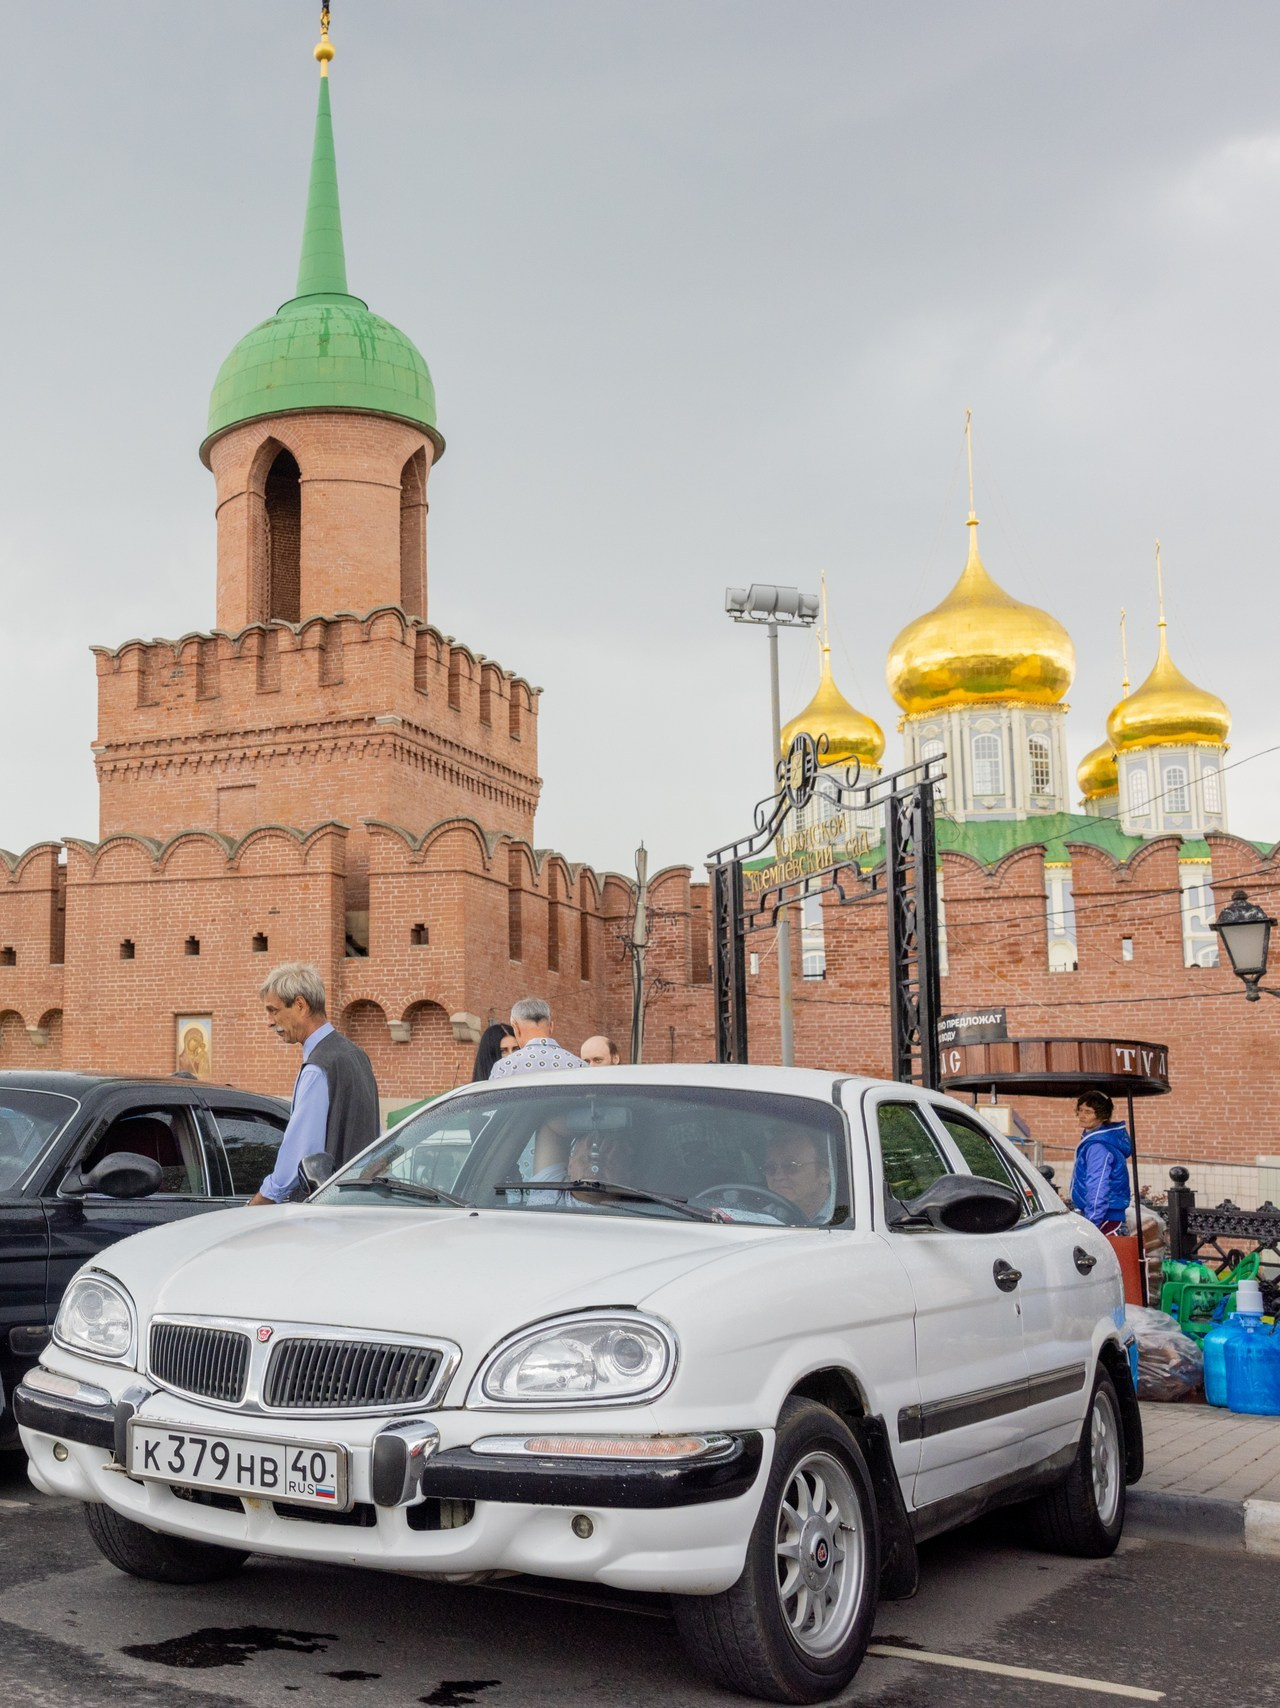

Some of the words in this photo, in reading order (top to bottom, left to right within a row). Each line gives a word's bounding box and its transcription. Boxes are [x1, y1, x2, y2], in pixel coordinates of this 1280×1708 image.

[947, 1014, 1002, 1029] ПРЕДЛОЖАТ
[291, 1450, 327, 1484] 40
[288, 1481, 315, 1495] RUS
